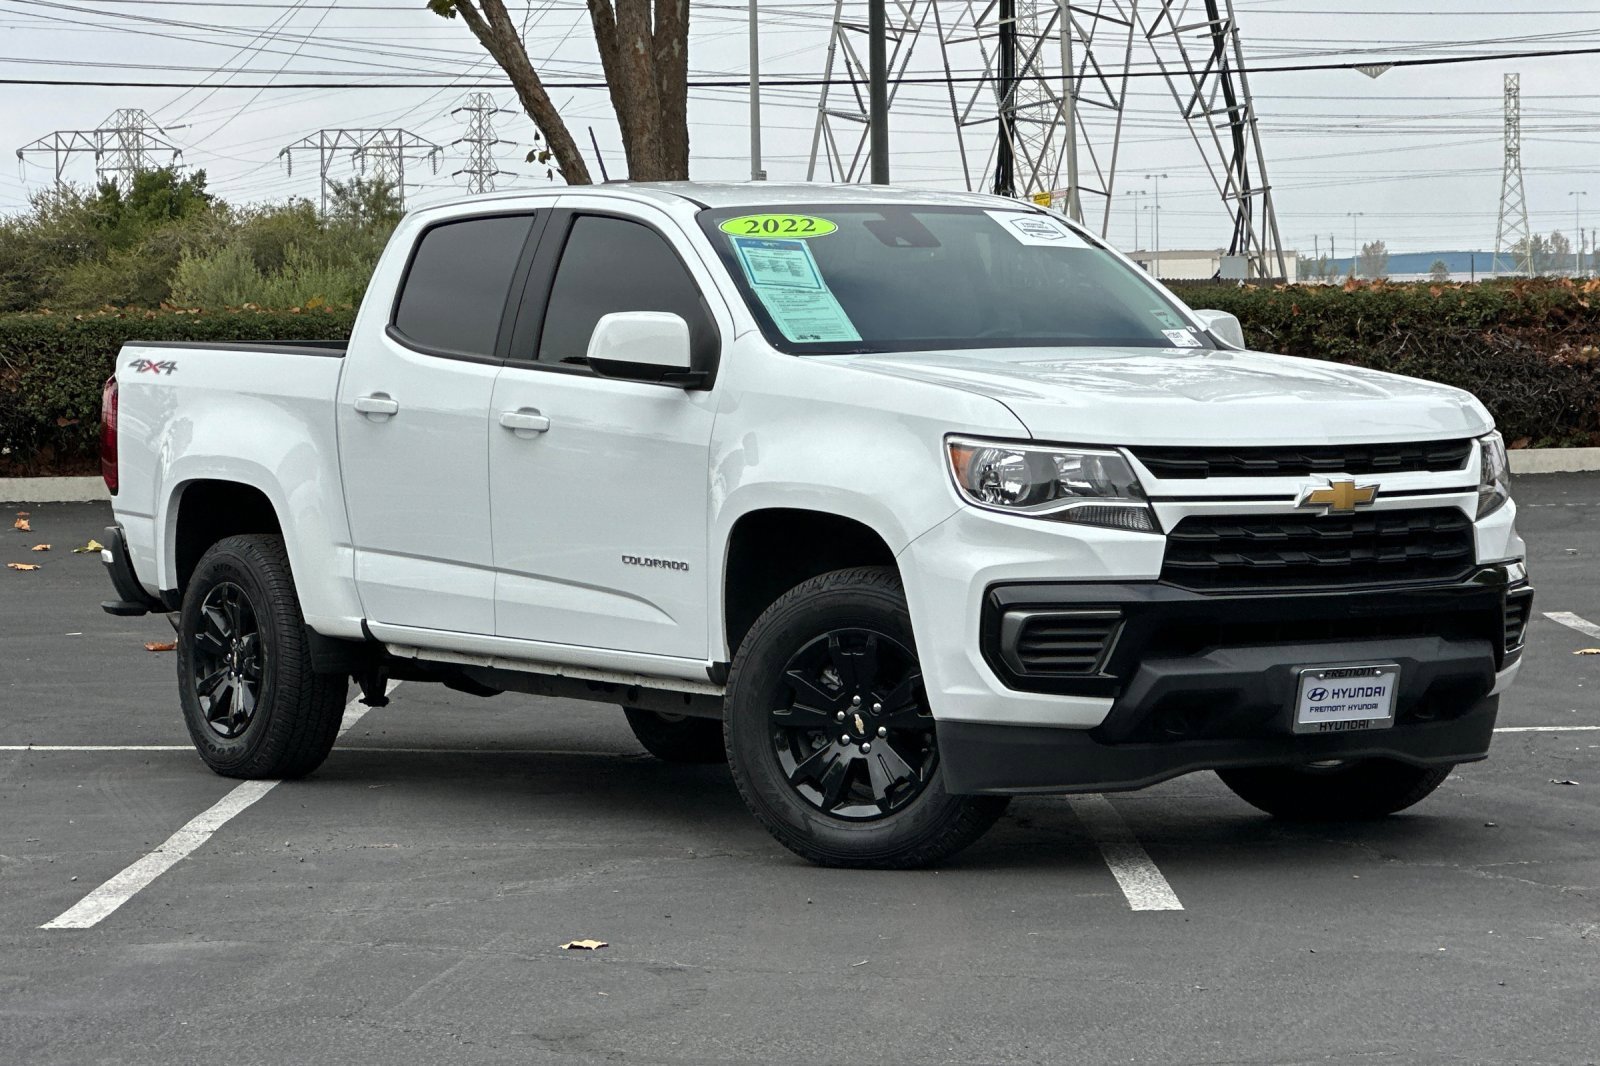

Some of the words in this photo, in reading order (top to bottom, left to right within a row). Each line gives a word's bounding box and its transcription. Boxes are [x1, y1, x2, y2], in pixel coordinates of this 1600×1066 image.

[744, 218, 817, 234] 2022
[621, 555, 690, 571] COLORADO
[1324, 667, 1376, 679] FREMONT
[1331, 686, 1386, 699] HYUNDAI
[1309, 704, 1346, 713] FREMONT
[1347, 703, 1379, 711] HYUNDAI
[1319, 720, 1369, 731] HYUNDAI
